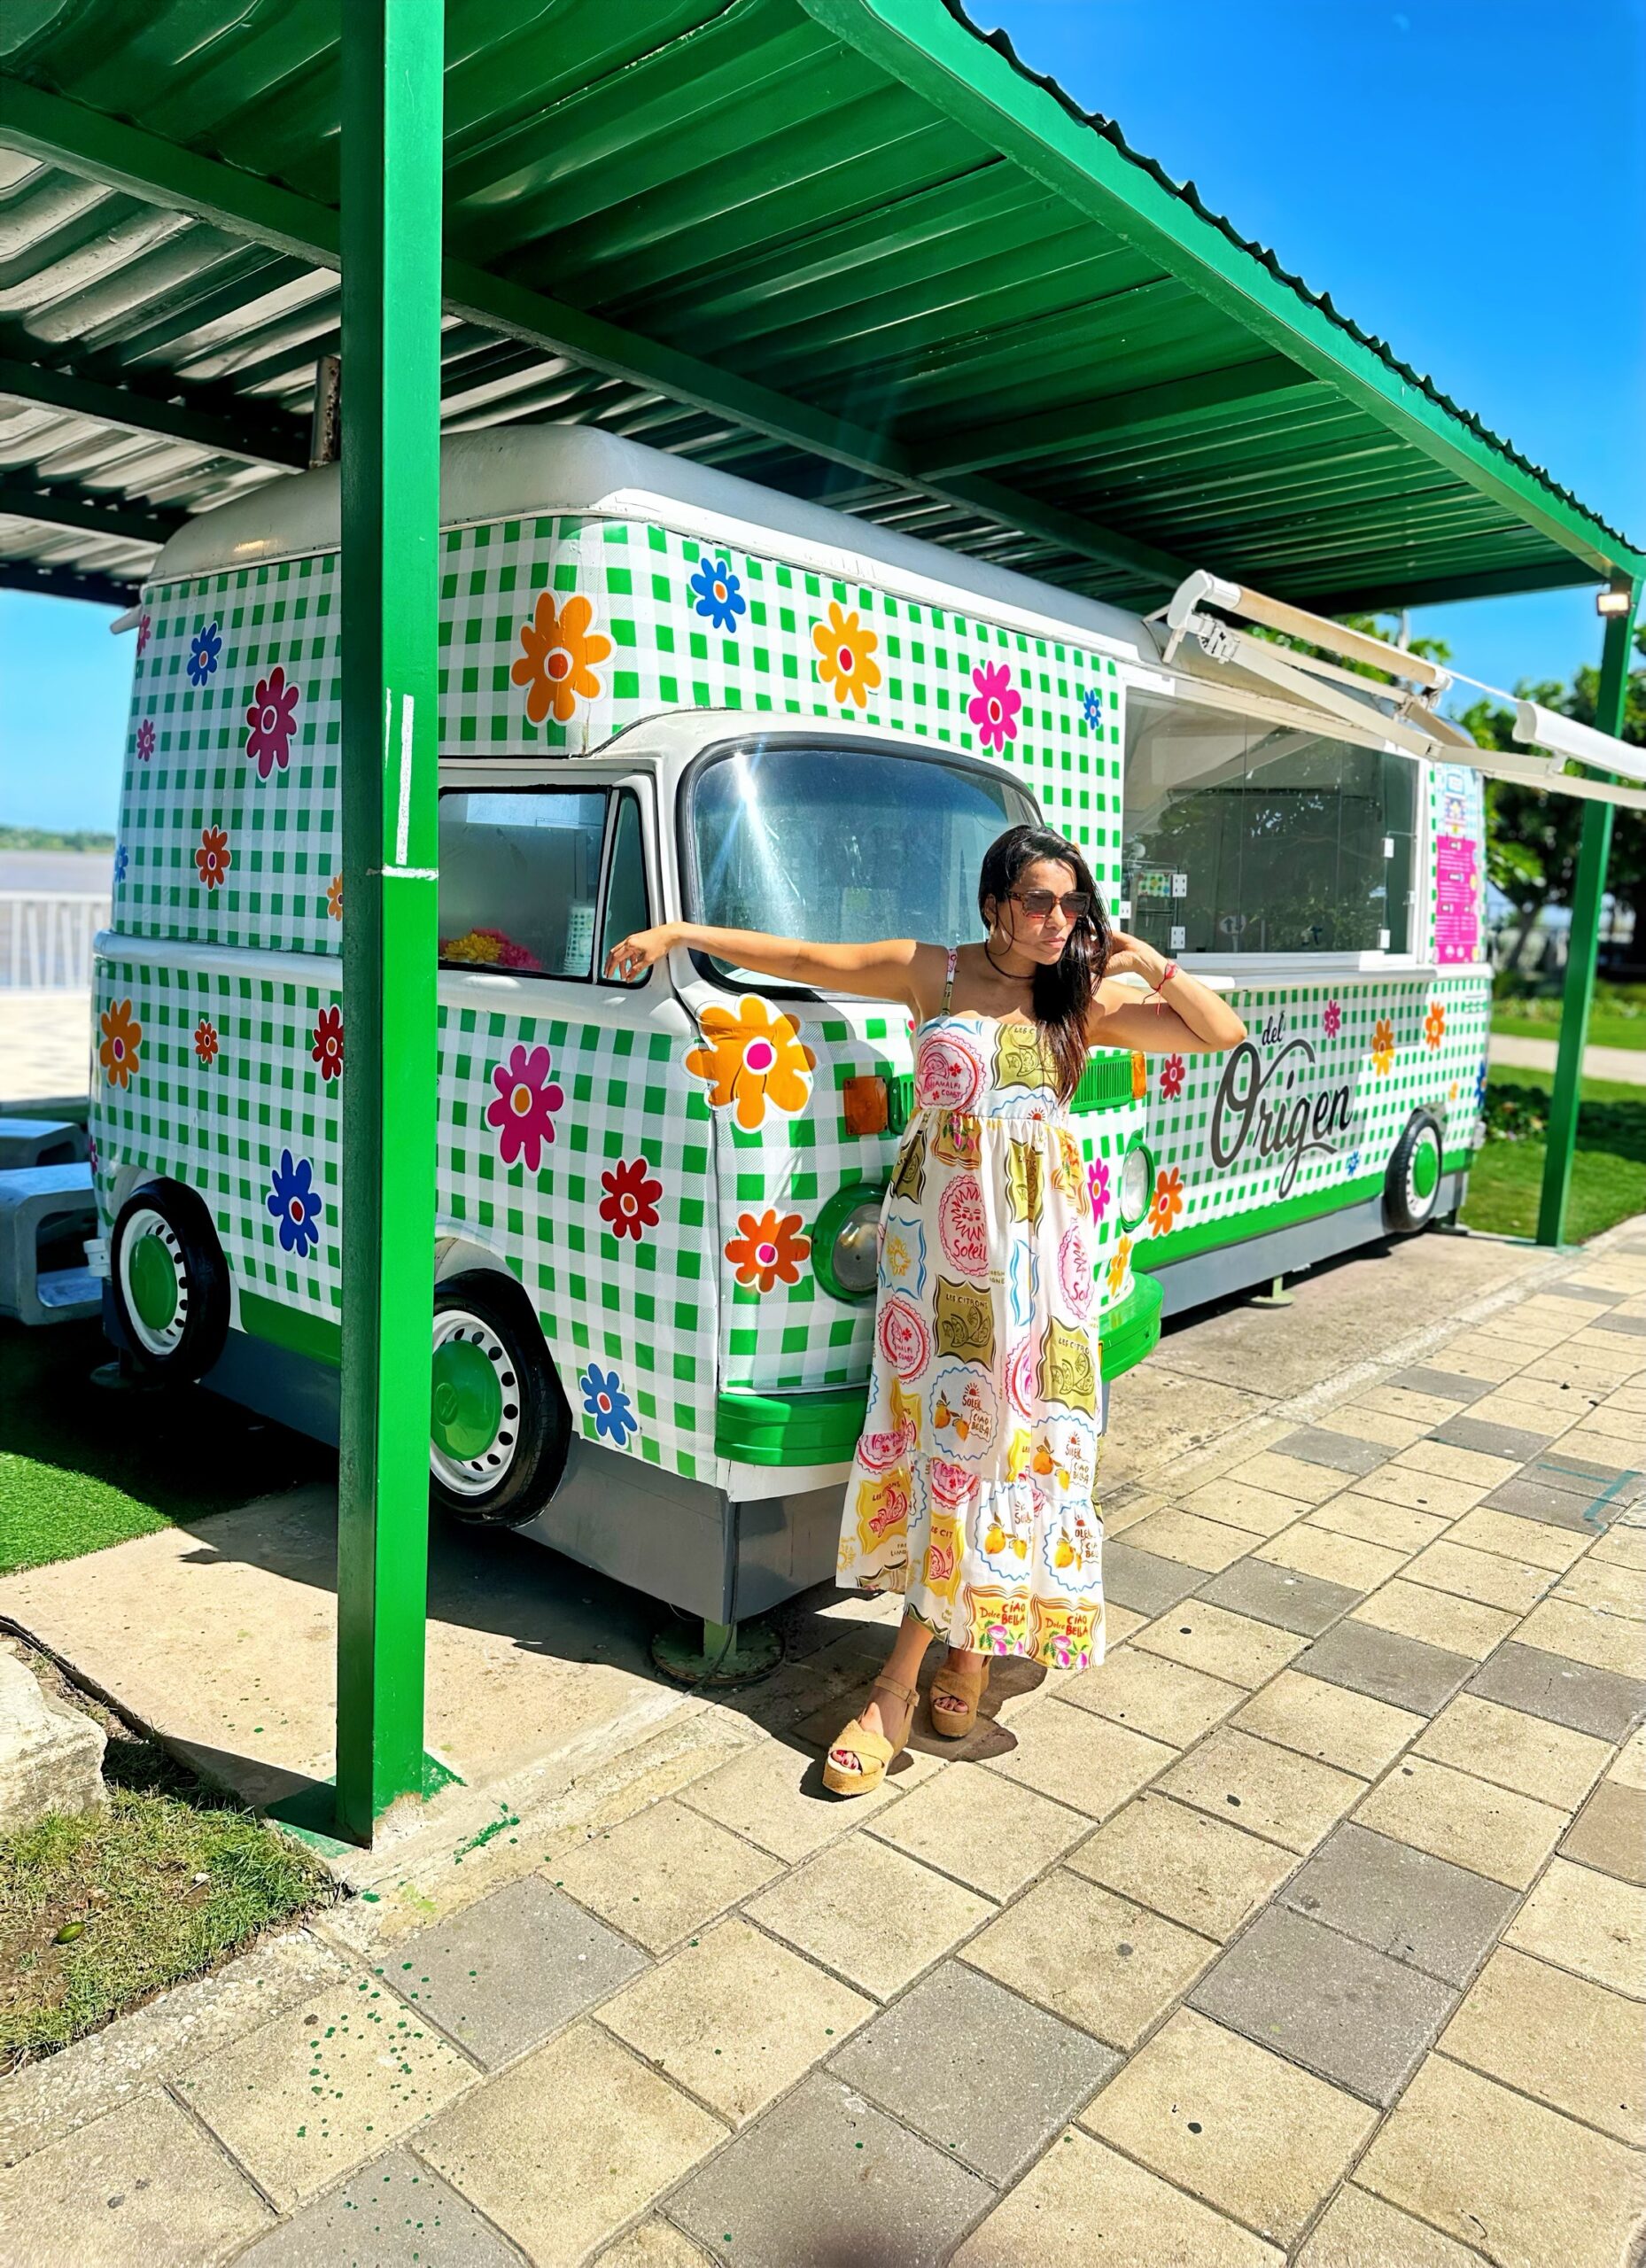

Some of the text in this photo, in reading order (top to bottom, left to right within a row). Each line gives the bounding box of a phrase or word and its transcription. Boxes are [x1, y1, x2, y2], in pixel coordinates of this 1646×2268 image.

[1262, 1010, 1285, 1046] del
[1210, 1038, 1354, 1200] Origen
[952, 1239, 988, 1262] Soleil
[945, 1293, 956, 1302] LES
[973, 1413, 990, 1425] CIAO
[971, 1421, 990, 1437] BELLA
[1001, 1613, 1026, 1626] BELLA
[1066, 1624, 1089, 1638] BELLA
